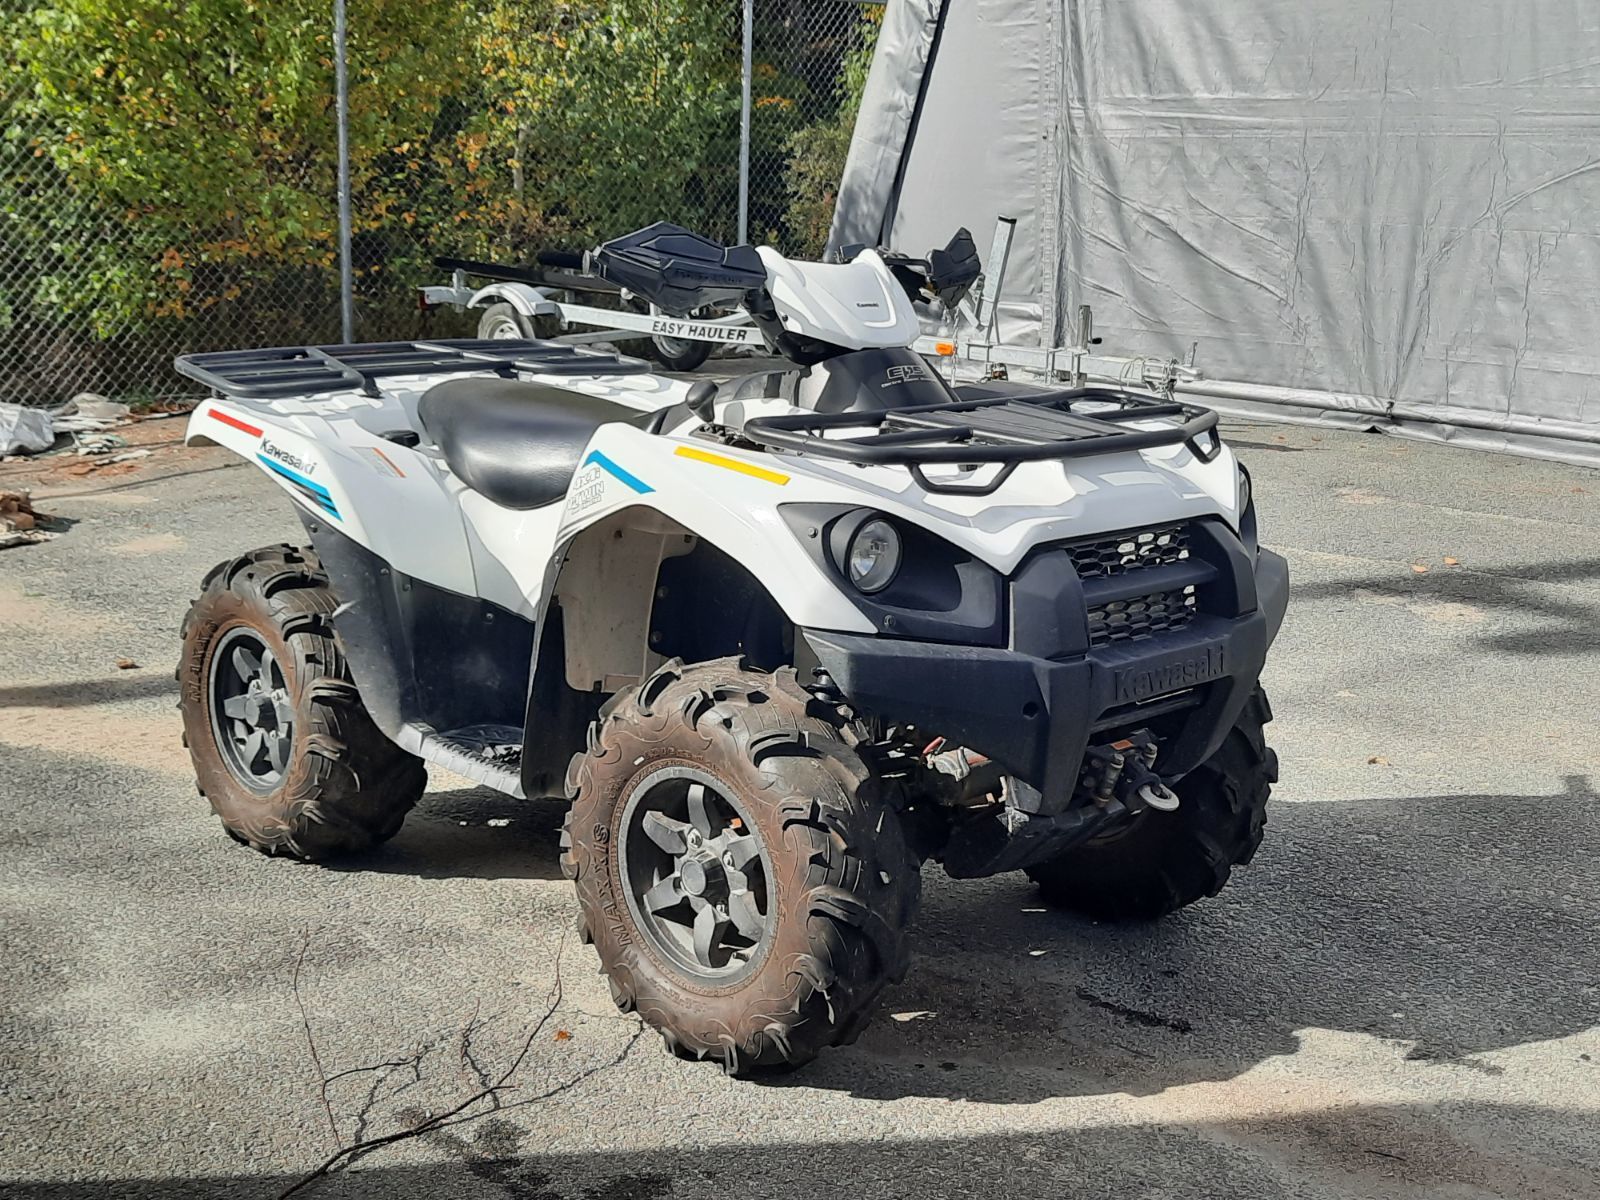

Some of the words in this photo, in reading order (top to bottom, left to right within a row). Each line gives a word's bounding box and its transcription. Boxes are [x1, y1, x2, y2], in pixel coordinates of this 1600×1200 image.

[652, 320, 684, 335] EASY
[688, 325, 748, 341] HAULER
[886, 364, 925, 379] EPS
[1114, 644, 1225, 701] Kawasaki
[593, 822, 633, 948] MAXXIS
